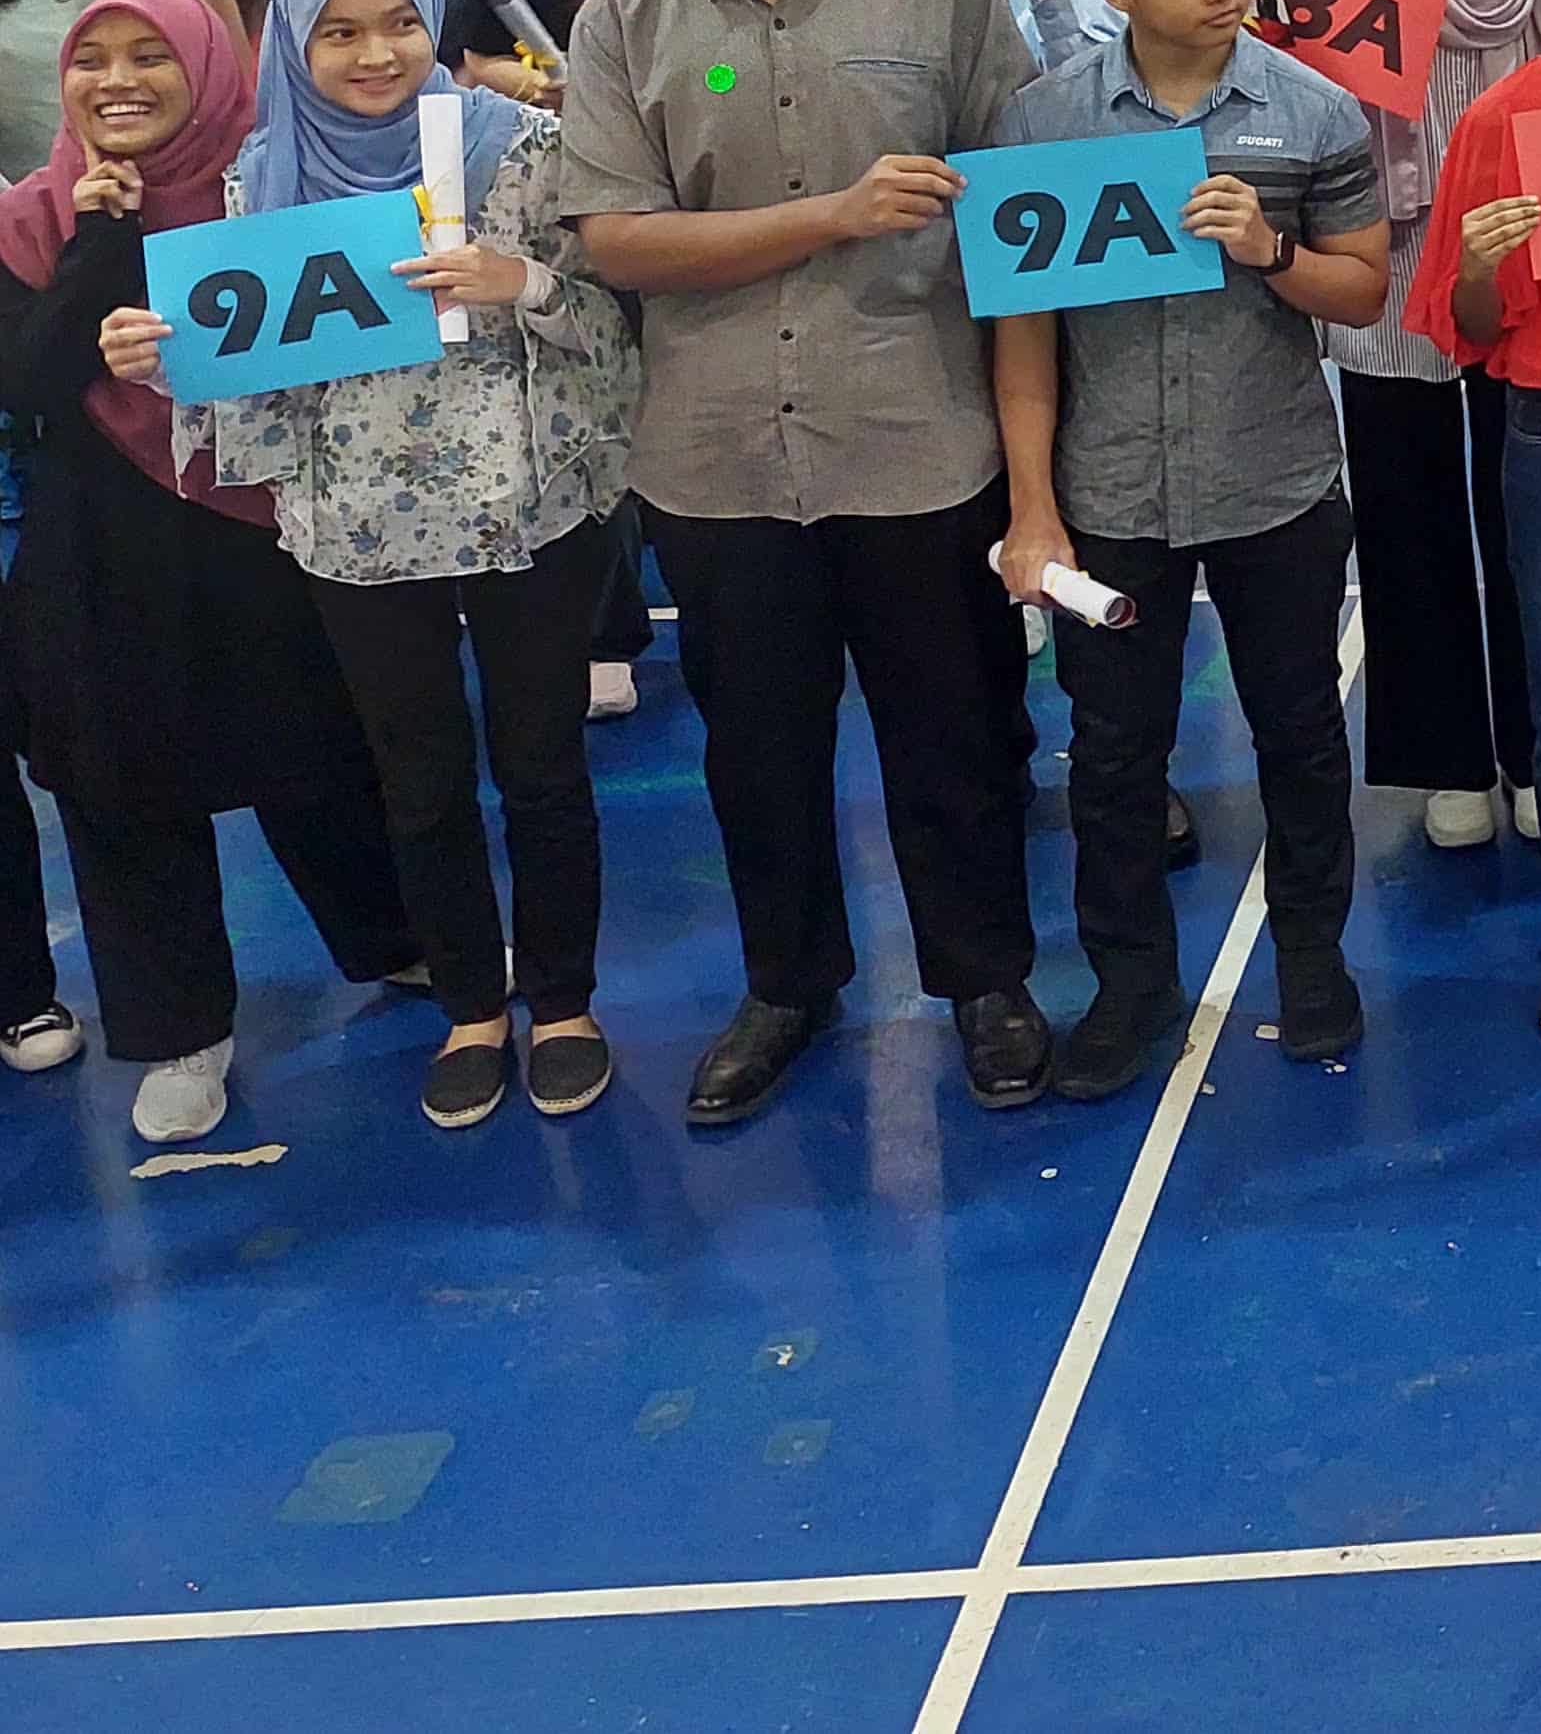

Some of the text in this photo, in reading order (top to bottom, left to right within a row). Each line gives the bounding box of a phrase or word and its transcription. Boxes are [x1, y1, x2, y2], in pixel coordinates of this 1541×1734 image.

[1236, 135, 1284, 149] DUCATI
[993, 181, 1178, 275] 9A
[187, 249, 392, 359] 9A
